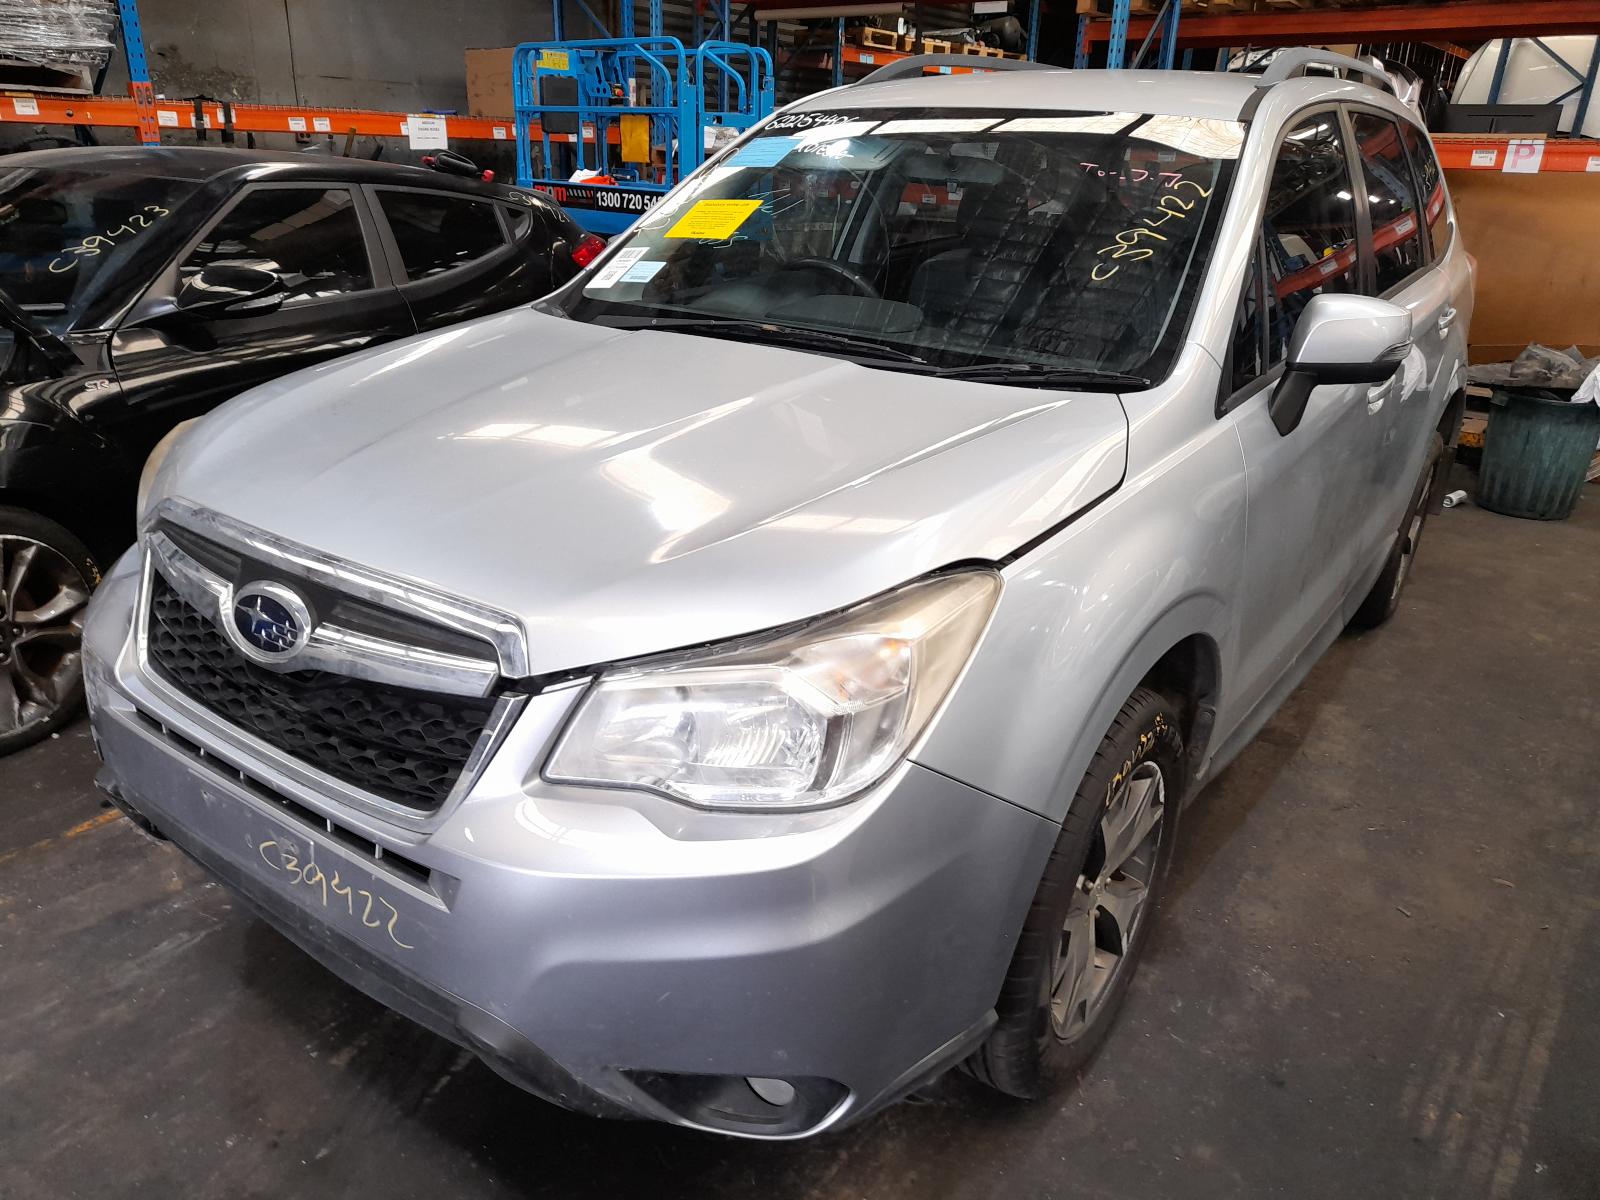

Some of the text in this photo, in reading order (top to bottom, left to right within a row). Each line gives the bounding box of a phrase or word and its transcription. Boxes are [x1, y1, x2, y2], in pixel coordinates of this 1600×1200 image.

[1511, 144, 1536, 169] P
[596, 191, 663, 211] 1300 720 54
[1091, 180, 1212, 281] C39422
[48, 205, 170, 274] C39423
[259, 841, 415, 949] C39422
